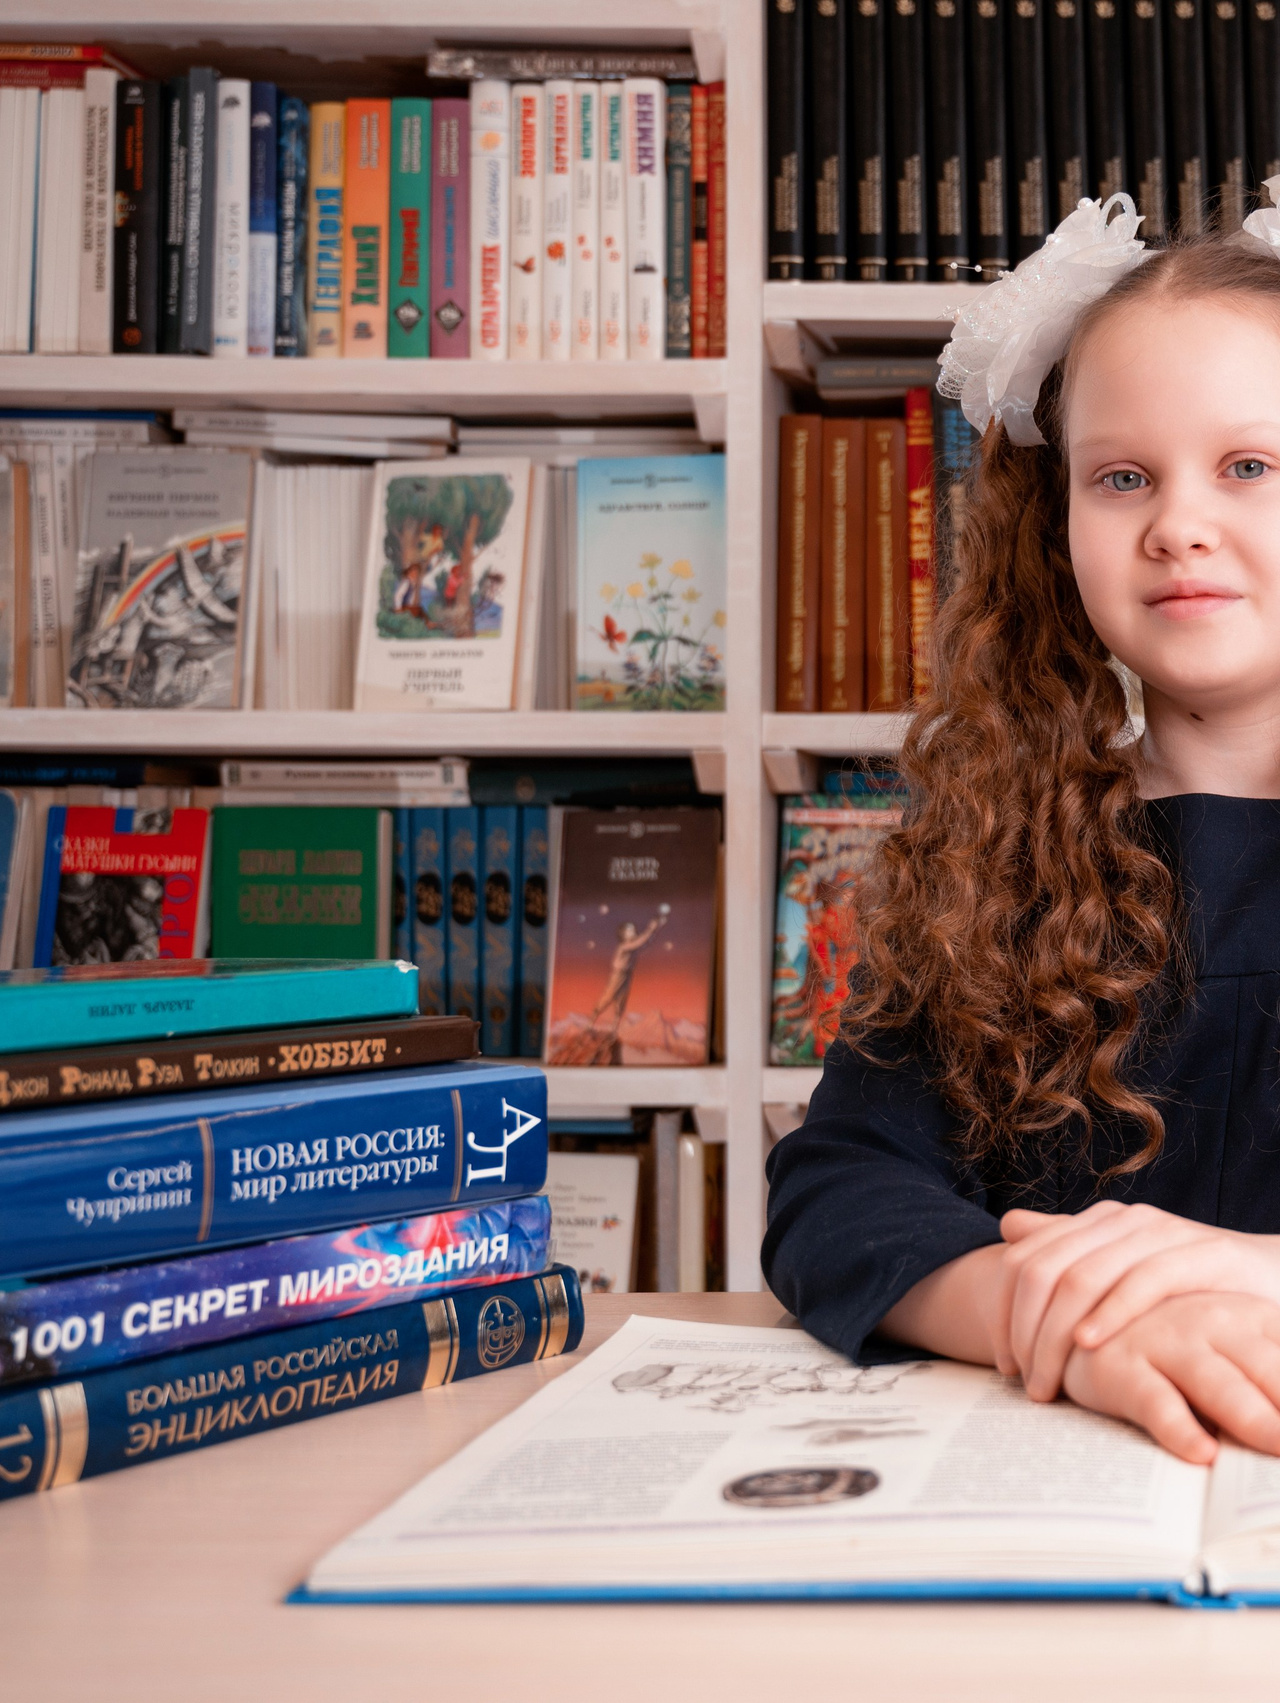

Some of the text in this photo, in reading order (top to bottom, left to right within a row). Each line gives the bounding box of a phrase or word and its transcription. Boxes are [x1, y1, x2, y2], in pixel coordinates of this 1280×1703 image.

[521, 96, 536, 178] ЗООЛОГИЯ
[636, 93, 655, 176] ХИМИЯ
[481, 244, 500, 348] СПРАВОЧНИК
[909, 487, 931, 560] ВЕКА
[55, 835, 110, 855] СКАЗКИ
[62, 854, 197, 873] МАТУШКИ ГУСЫНИ
[87, 998, 195, 1018] ЛАЗАРЬ ЛАГИН
[278, 1037, 388, 1072] ХОББИТ
[231, 1124, 446, 1176] НОВАЯ РОССИЯ:
[107, 1160, 194, 1194] Сергей
[230, 1153, 439, 1204] мир литературы
[66, 1186, 193, 1229] Чупринин
[11, 1234, 511, 1362] 1001 СЕКРЕТ МИРОЗДАНИЯ
[126, 1328, 400, 1415] БОЛЬШАЯ РОССИЙСКАЯ
[125, 1358, 401, 1457] ЭНЦИКЛОПЕДИЯ
